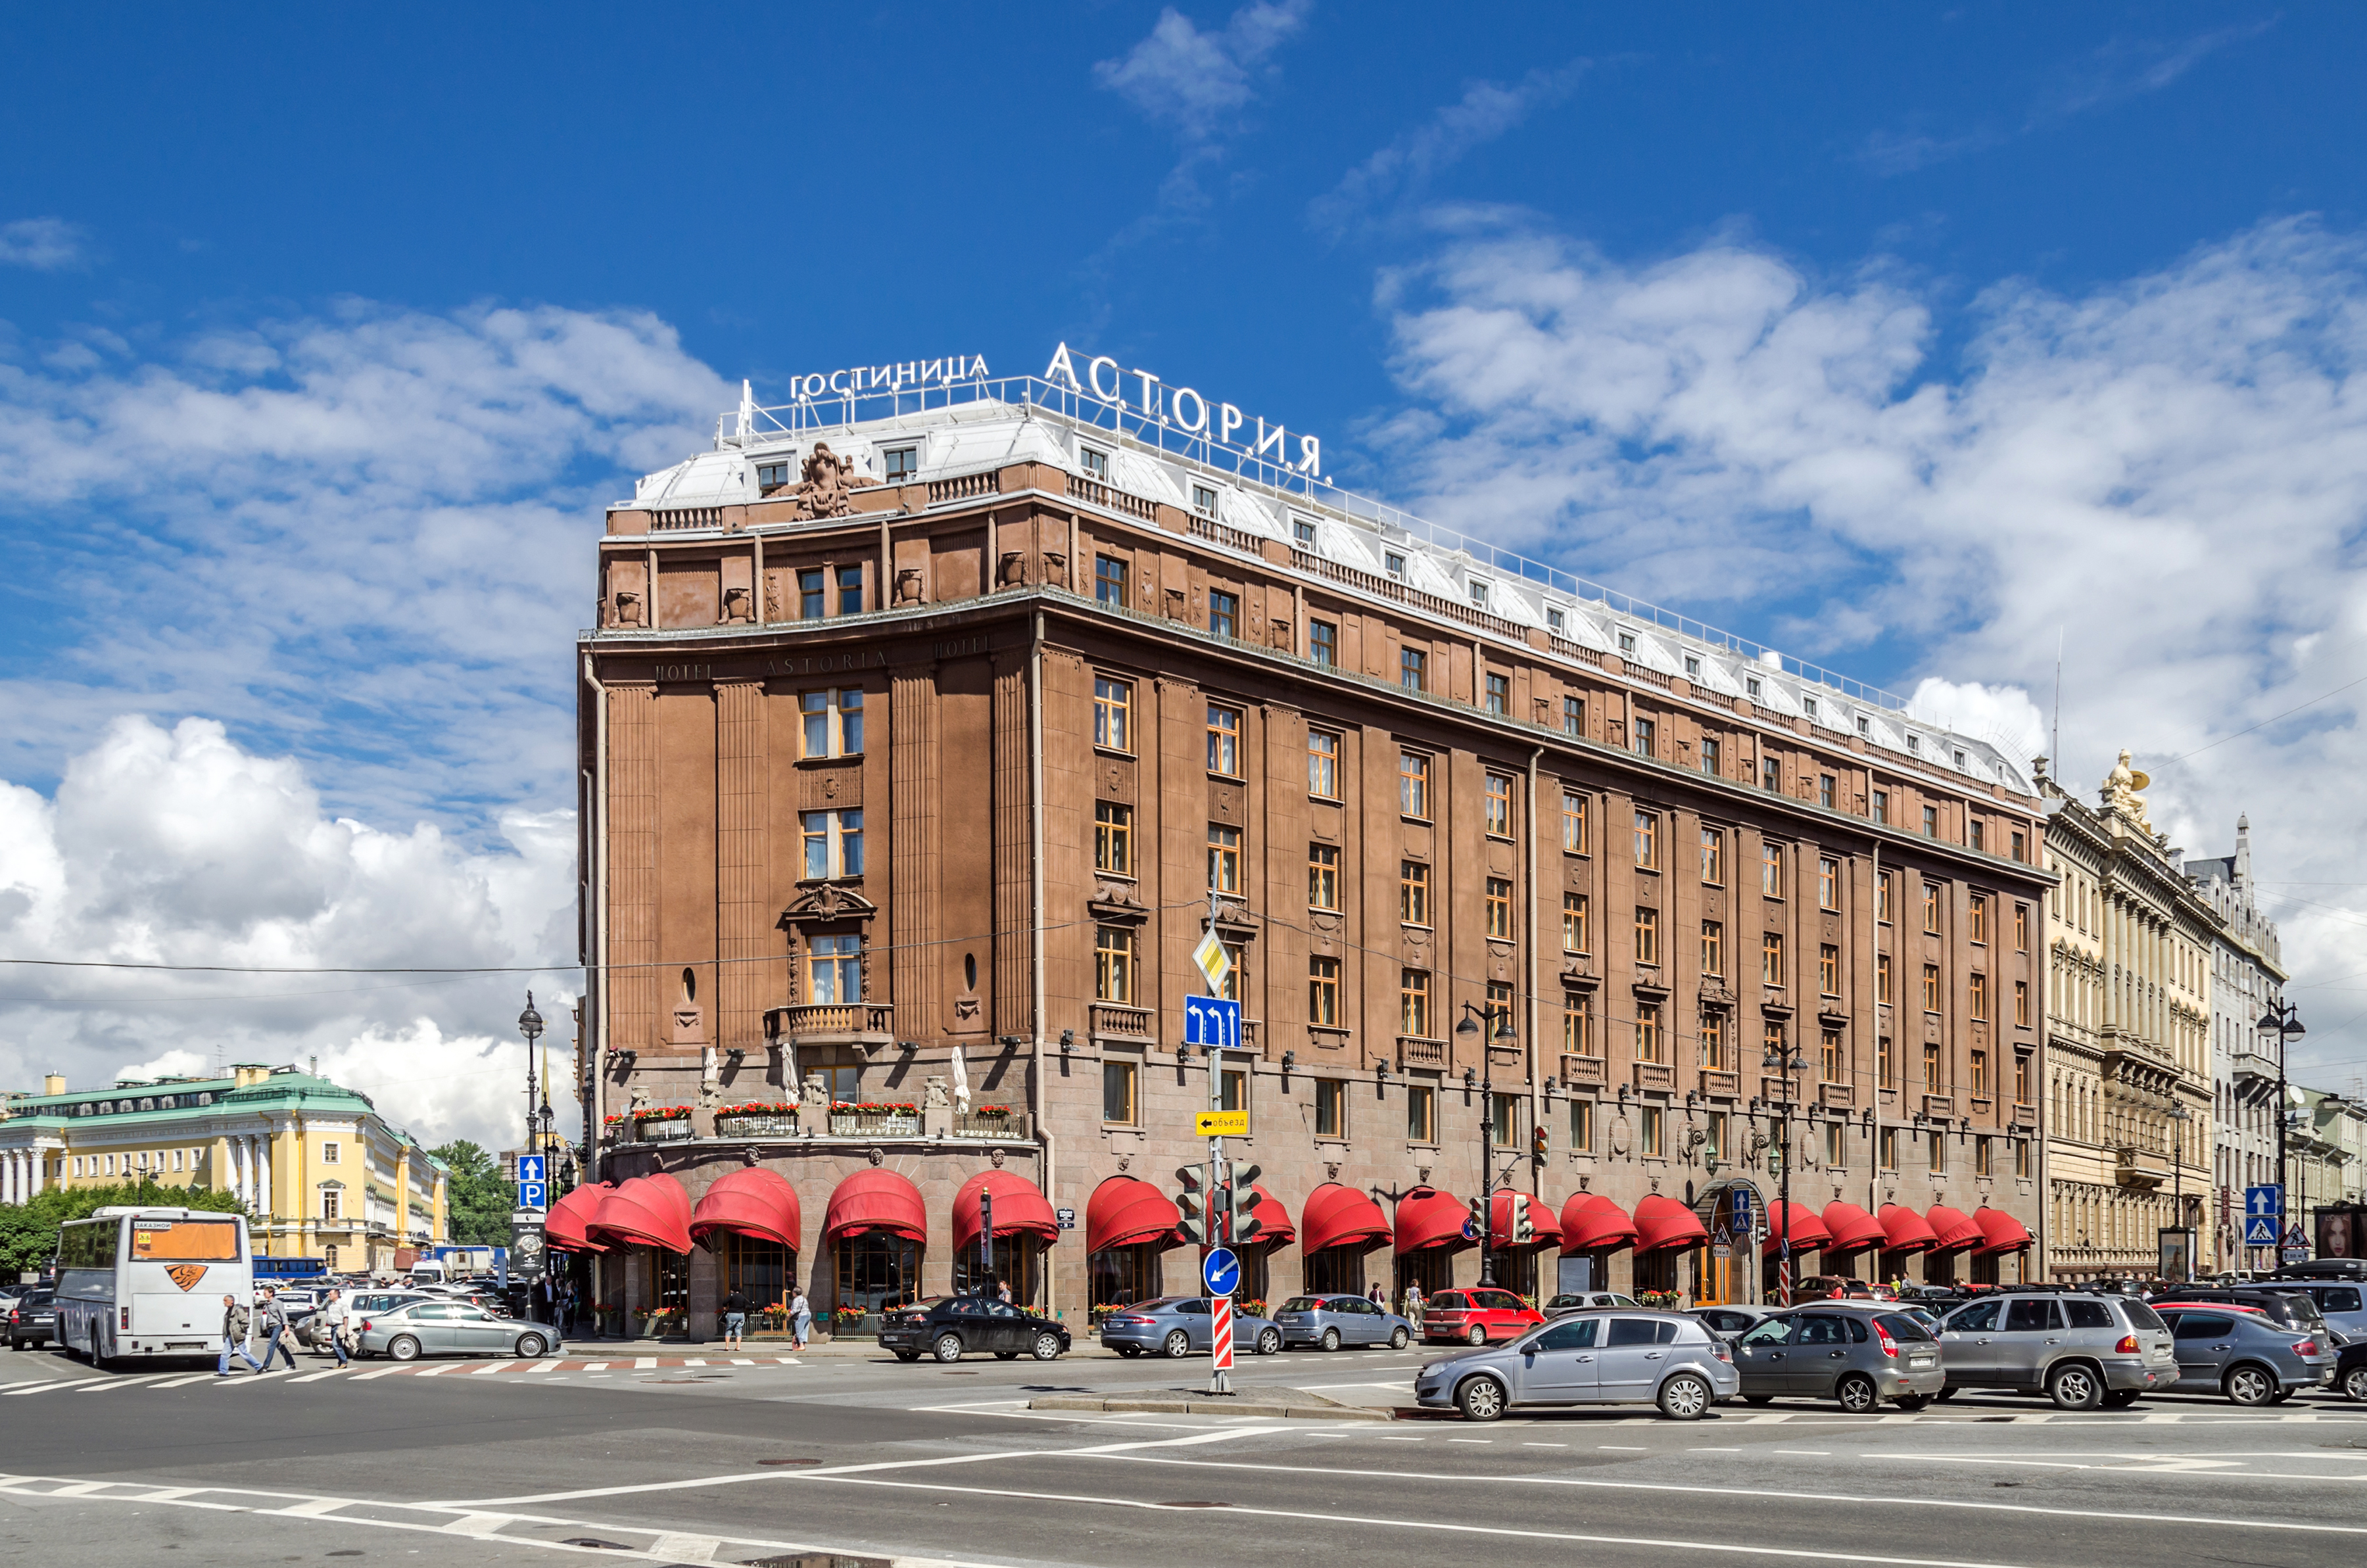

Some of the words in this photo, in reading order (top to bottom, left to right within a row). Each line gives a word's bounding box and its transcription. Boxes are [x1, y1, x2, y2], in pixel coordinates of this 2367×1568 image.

[791, 353, 990, 399] ГОСТИНИЦА
[1044, 341, 1320, 477] АСТОРИЯ
[656, 664, 711, 680] HOTEL
[765, 650, 886, 675] ASTORIA
[935, 635, 989, 658] HOTEL
[1212, 1117, 1245, 1128] объезд
[526, 1185, 541, 1203] P
